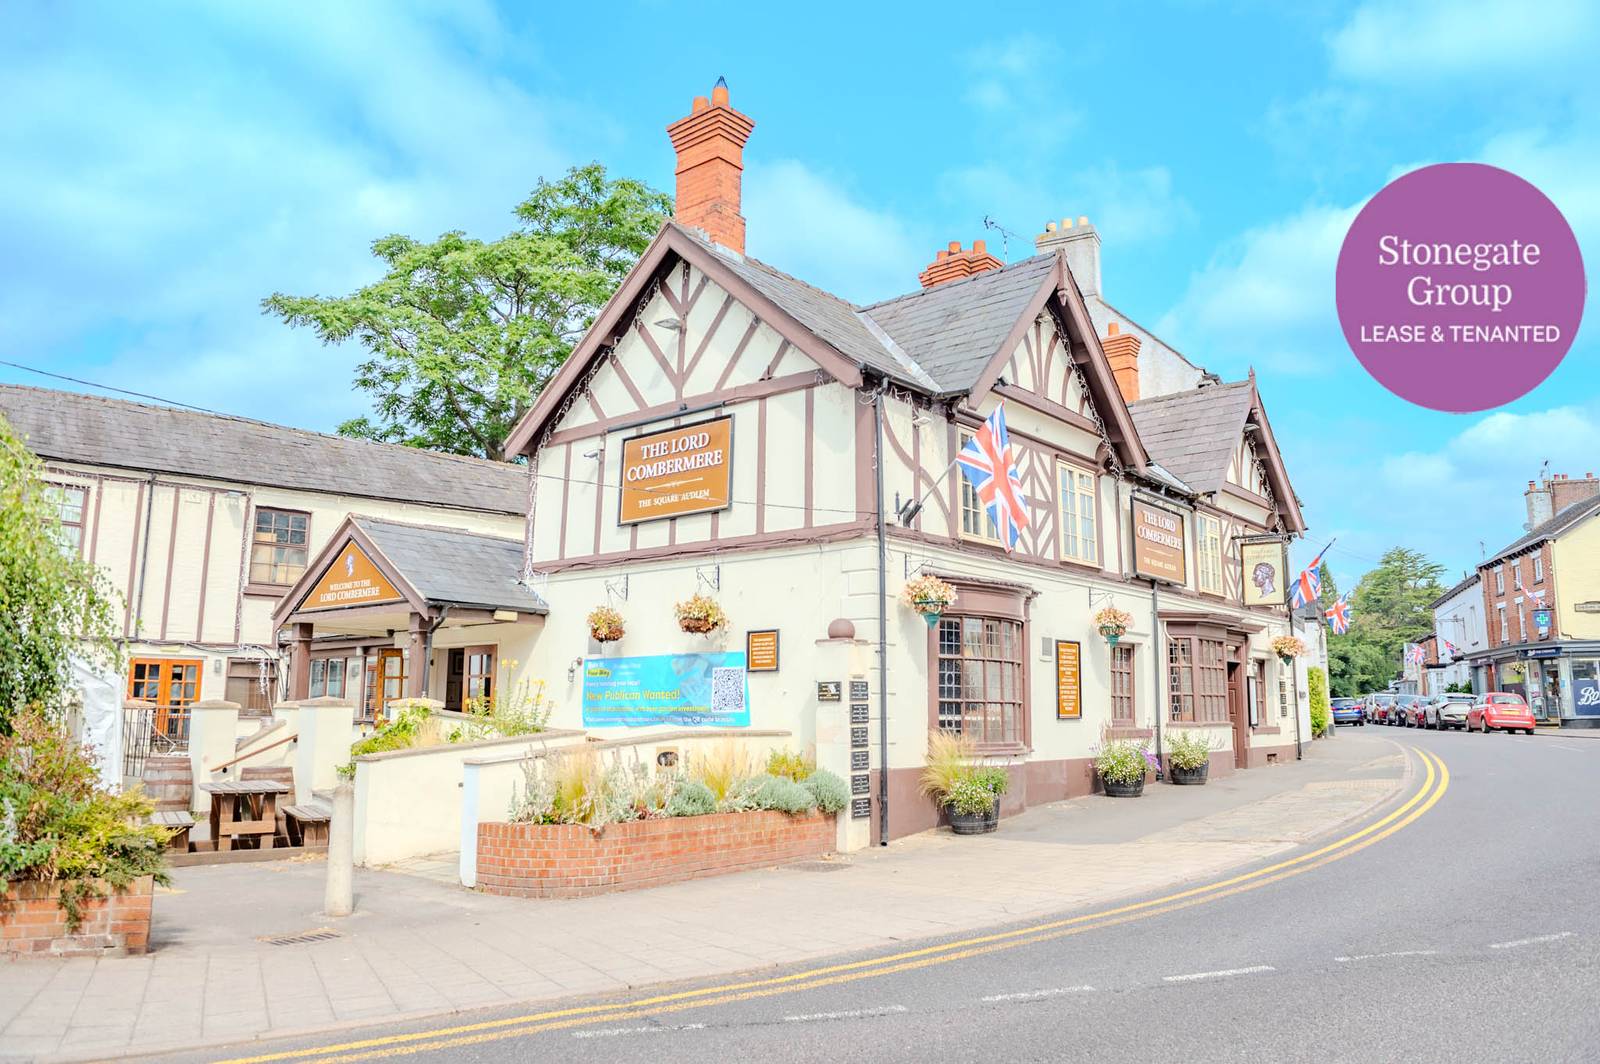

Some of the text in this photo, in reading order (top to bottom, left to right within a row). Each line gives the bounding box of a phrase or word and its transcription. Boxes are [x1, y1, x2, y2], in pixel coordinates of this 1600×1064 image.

[641, 432, 710, 459] THE LORD
[627, 449, 723, 482] COMBERMERE
[638, 498, 652, 508] THE
[653, 493, 679, 506] SQUARE
[1143, 511, 1176, 533] THE LORD
[1137, 525, 1182, 550] COMBERMERE
[320, 592, 337, 602] LORD
[605, 690, 641, 701] Publican
[643, 689, 680, 701] Wanted!
